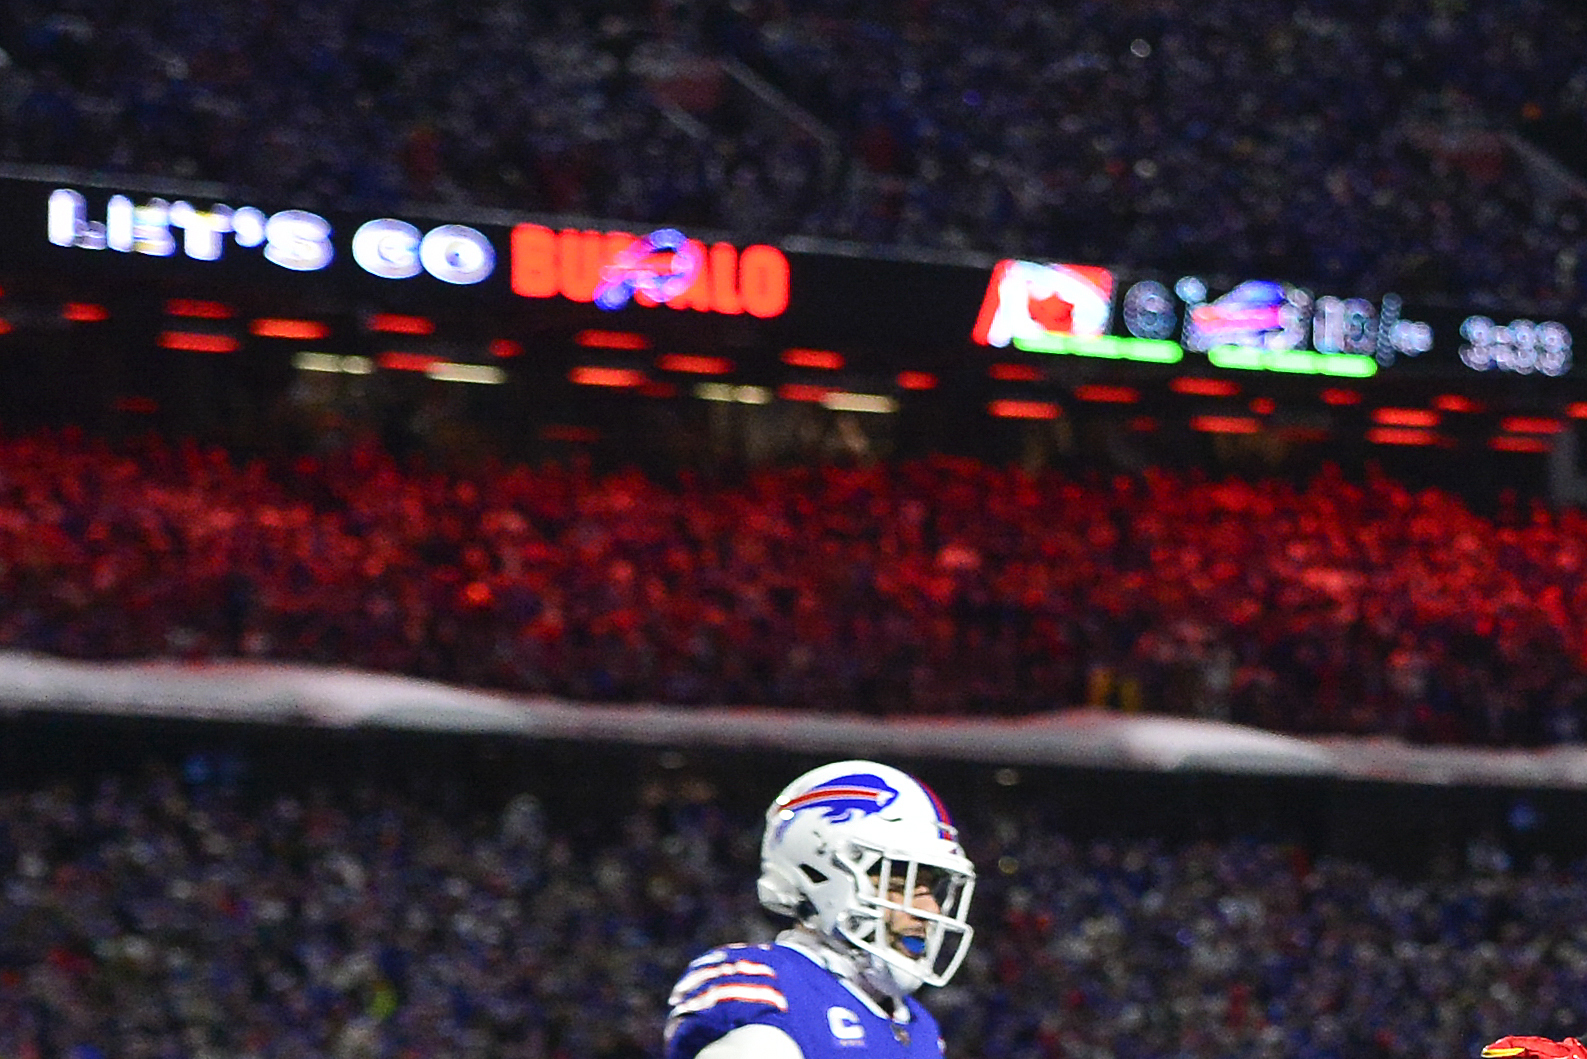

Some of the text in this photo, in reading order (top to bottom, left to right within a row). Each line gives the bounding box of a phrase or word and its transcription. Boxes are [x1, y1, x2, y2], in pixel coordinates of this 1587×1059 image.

[48, 188, 791, 319] LET'S GO BUALO
[827, 1005, 865, 1039] C
